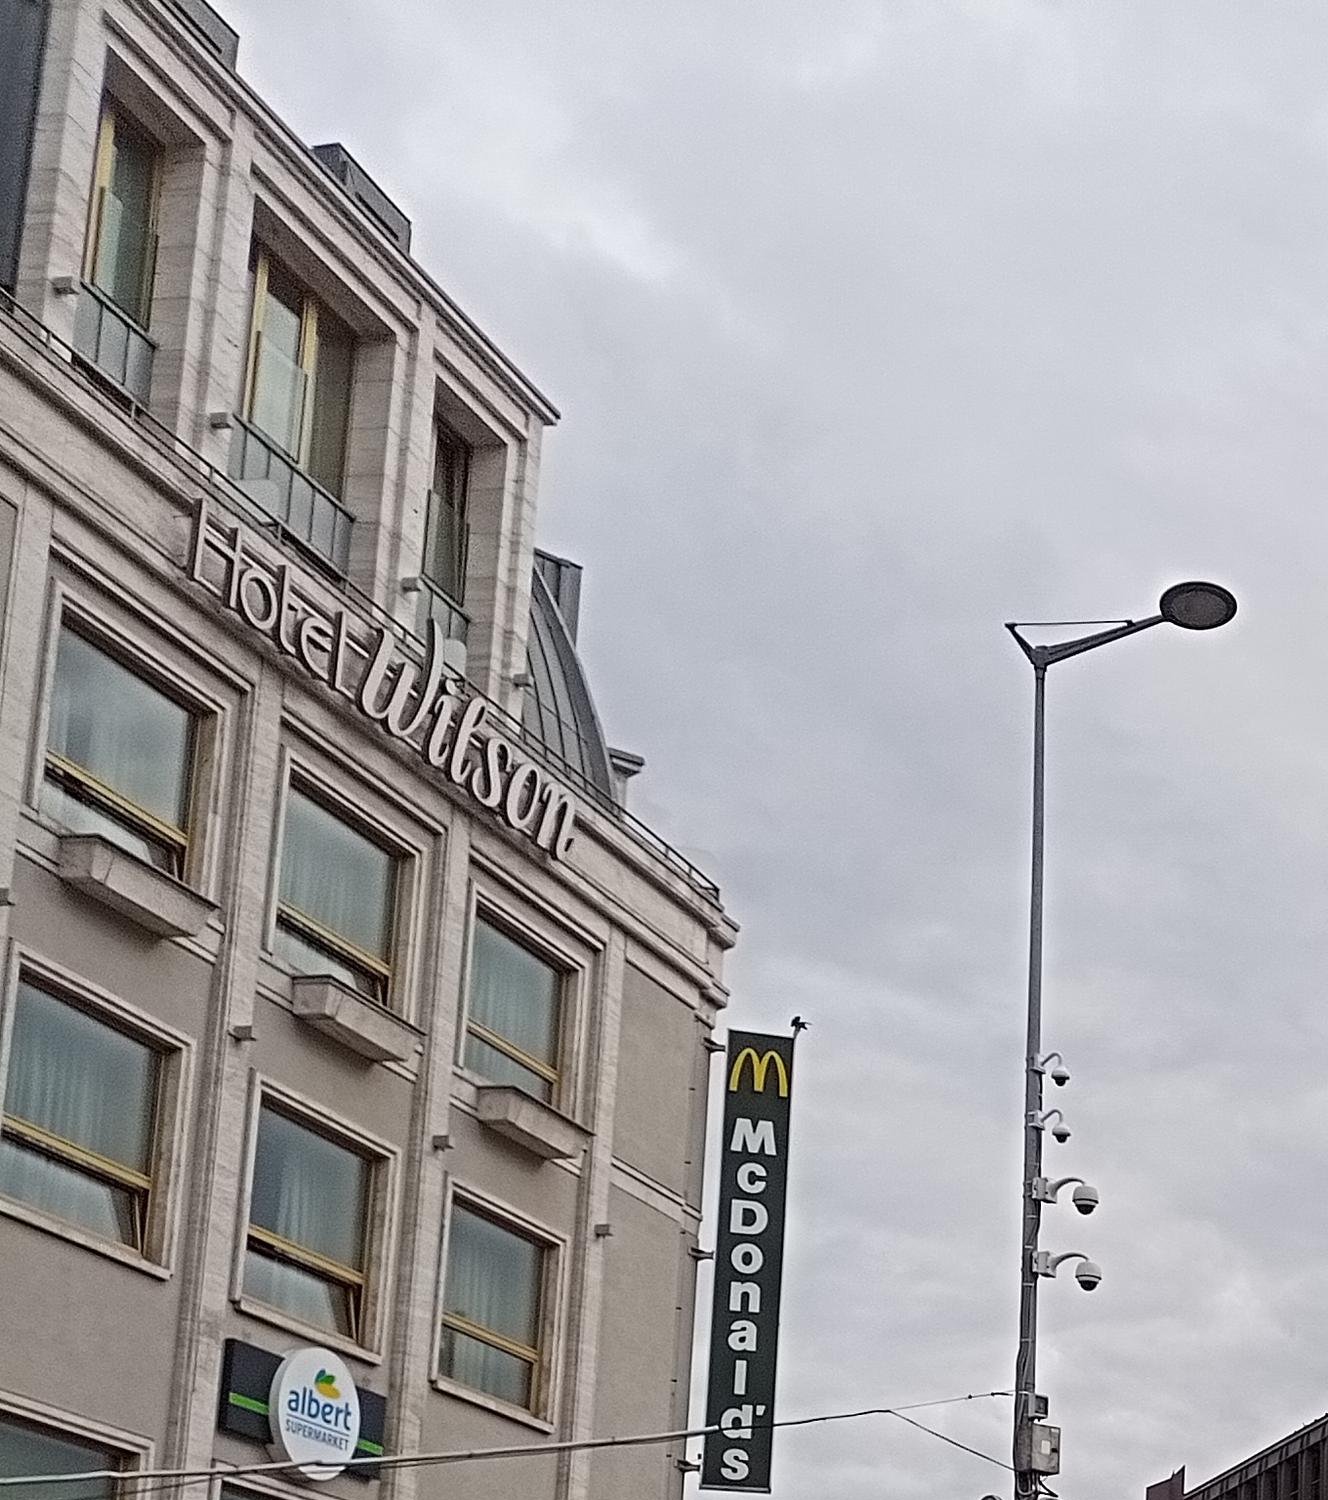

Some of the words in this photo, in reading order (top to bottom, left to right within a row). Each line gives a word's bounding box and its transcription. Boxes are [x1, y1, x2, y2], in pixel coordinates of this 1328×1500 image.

[190, 498, 358, 700] Hotel
[360, 618, 577, 860] Wilson
[719, 1117, 777, 1481] McDonald's
[285, 1419, 349, 1451] SUPERMARKET
[287, 1387, 352, 1431] albert
